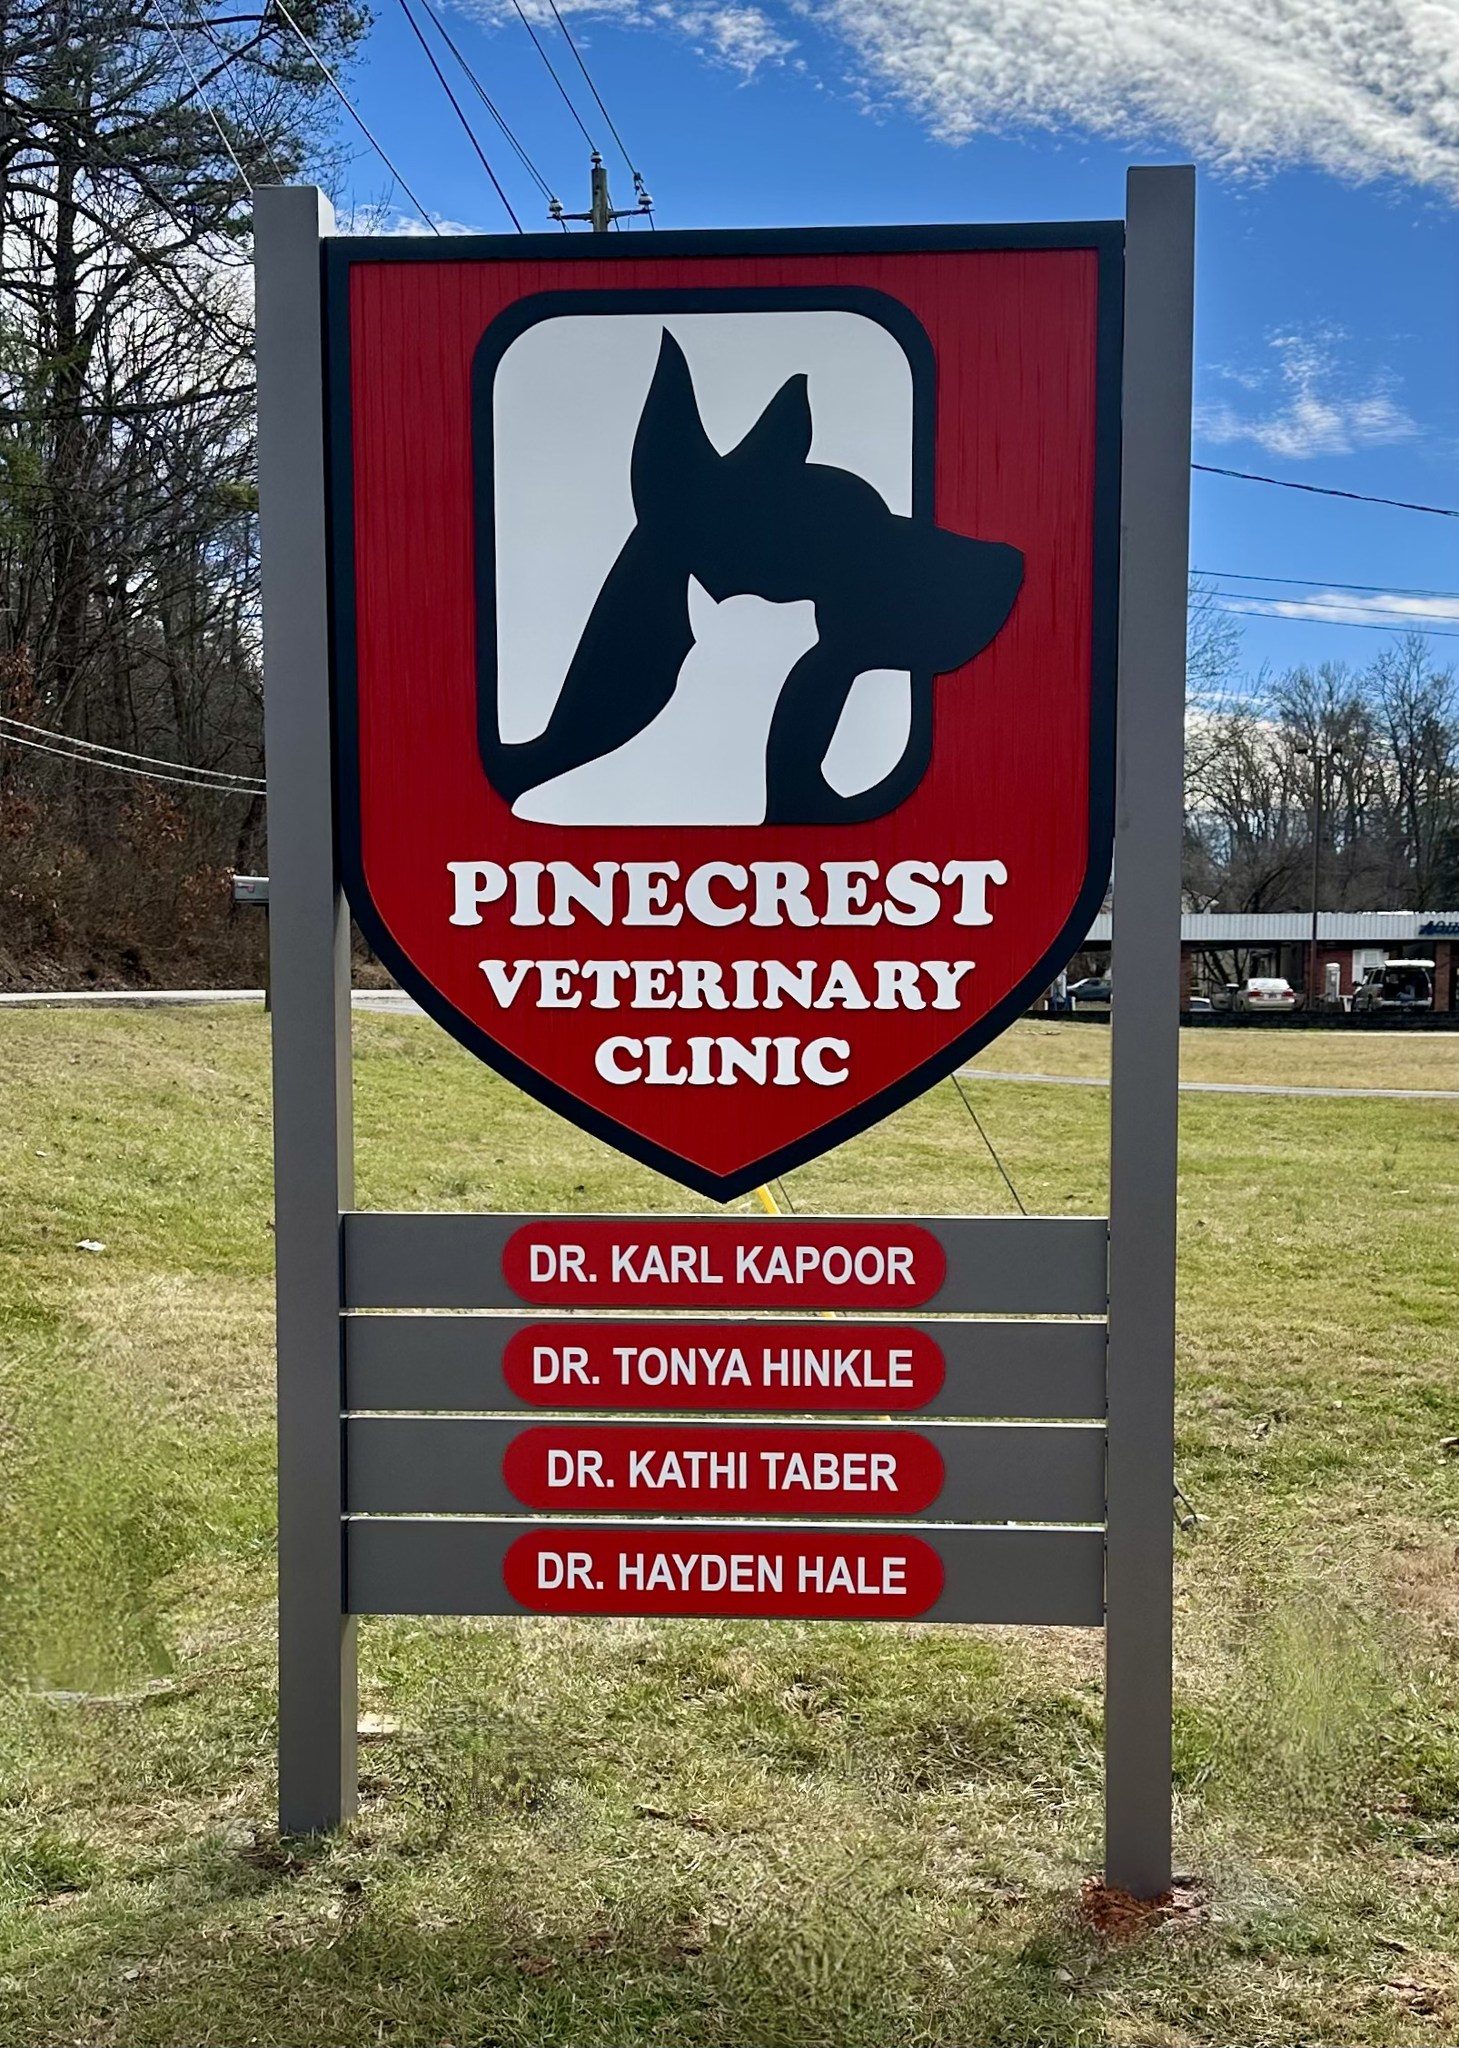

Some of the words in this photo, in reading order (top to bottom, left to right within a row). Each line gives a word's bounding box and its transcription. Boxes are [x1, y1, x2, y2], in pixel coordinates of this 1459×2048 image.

[447, 860, 1007, 926] PINECREST
[479, 960, 975, 1010] VETERINARY
[595, 1036, 850, 1085] CLINIC
[531, 1245, 597, 1282] DR.
[612, 1246, 723, 1283] KARL
[737, 1246, 915, 1284] KAPOOR
[534, 1347, 599, 1384] DR.
[613, 1348, 751, 1386] TONYA
[764, 1349, 913, 1387] HINKLE
[548, 1450, 614, 1487] DR.
[630, 1451, 746, 1489] KATHI
[760, 1452, 898, 1491] TABER
[538, 1552, 603, 1589] DR.
[619, 1553, 782, 1592] HAYDEN
[799, 1556, 906, 1594] HALE
